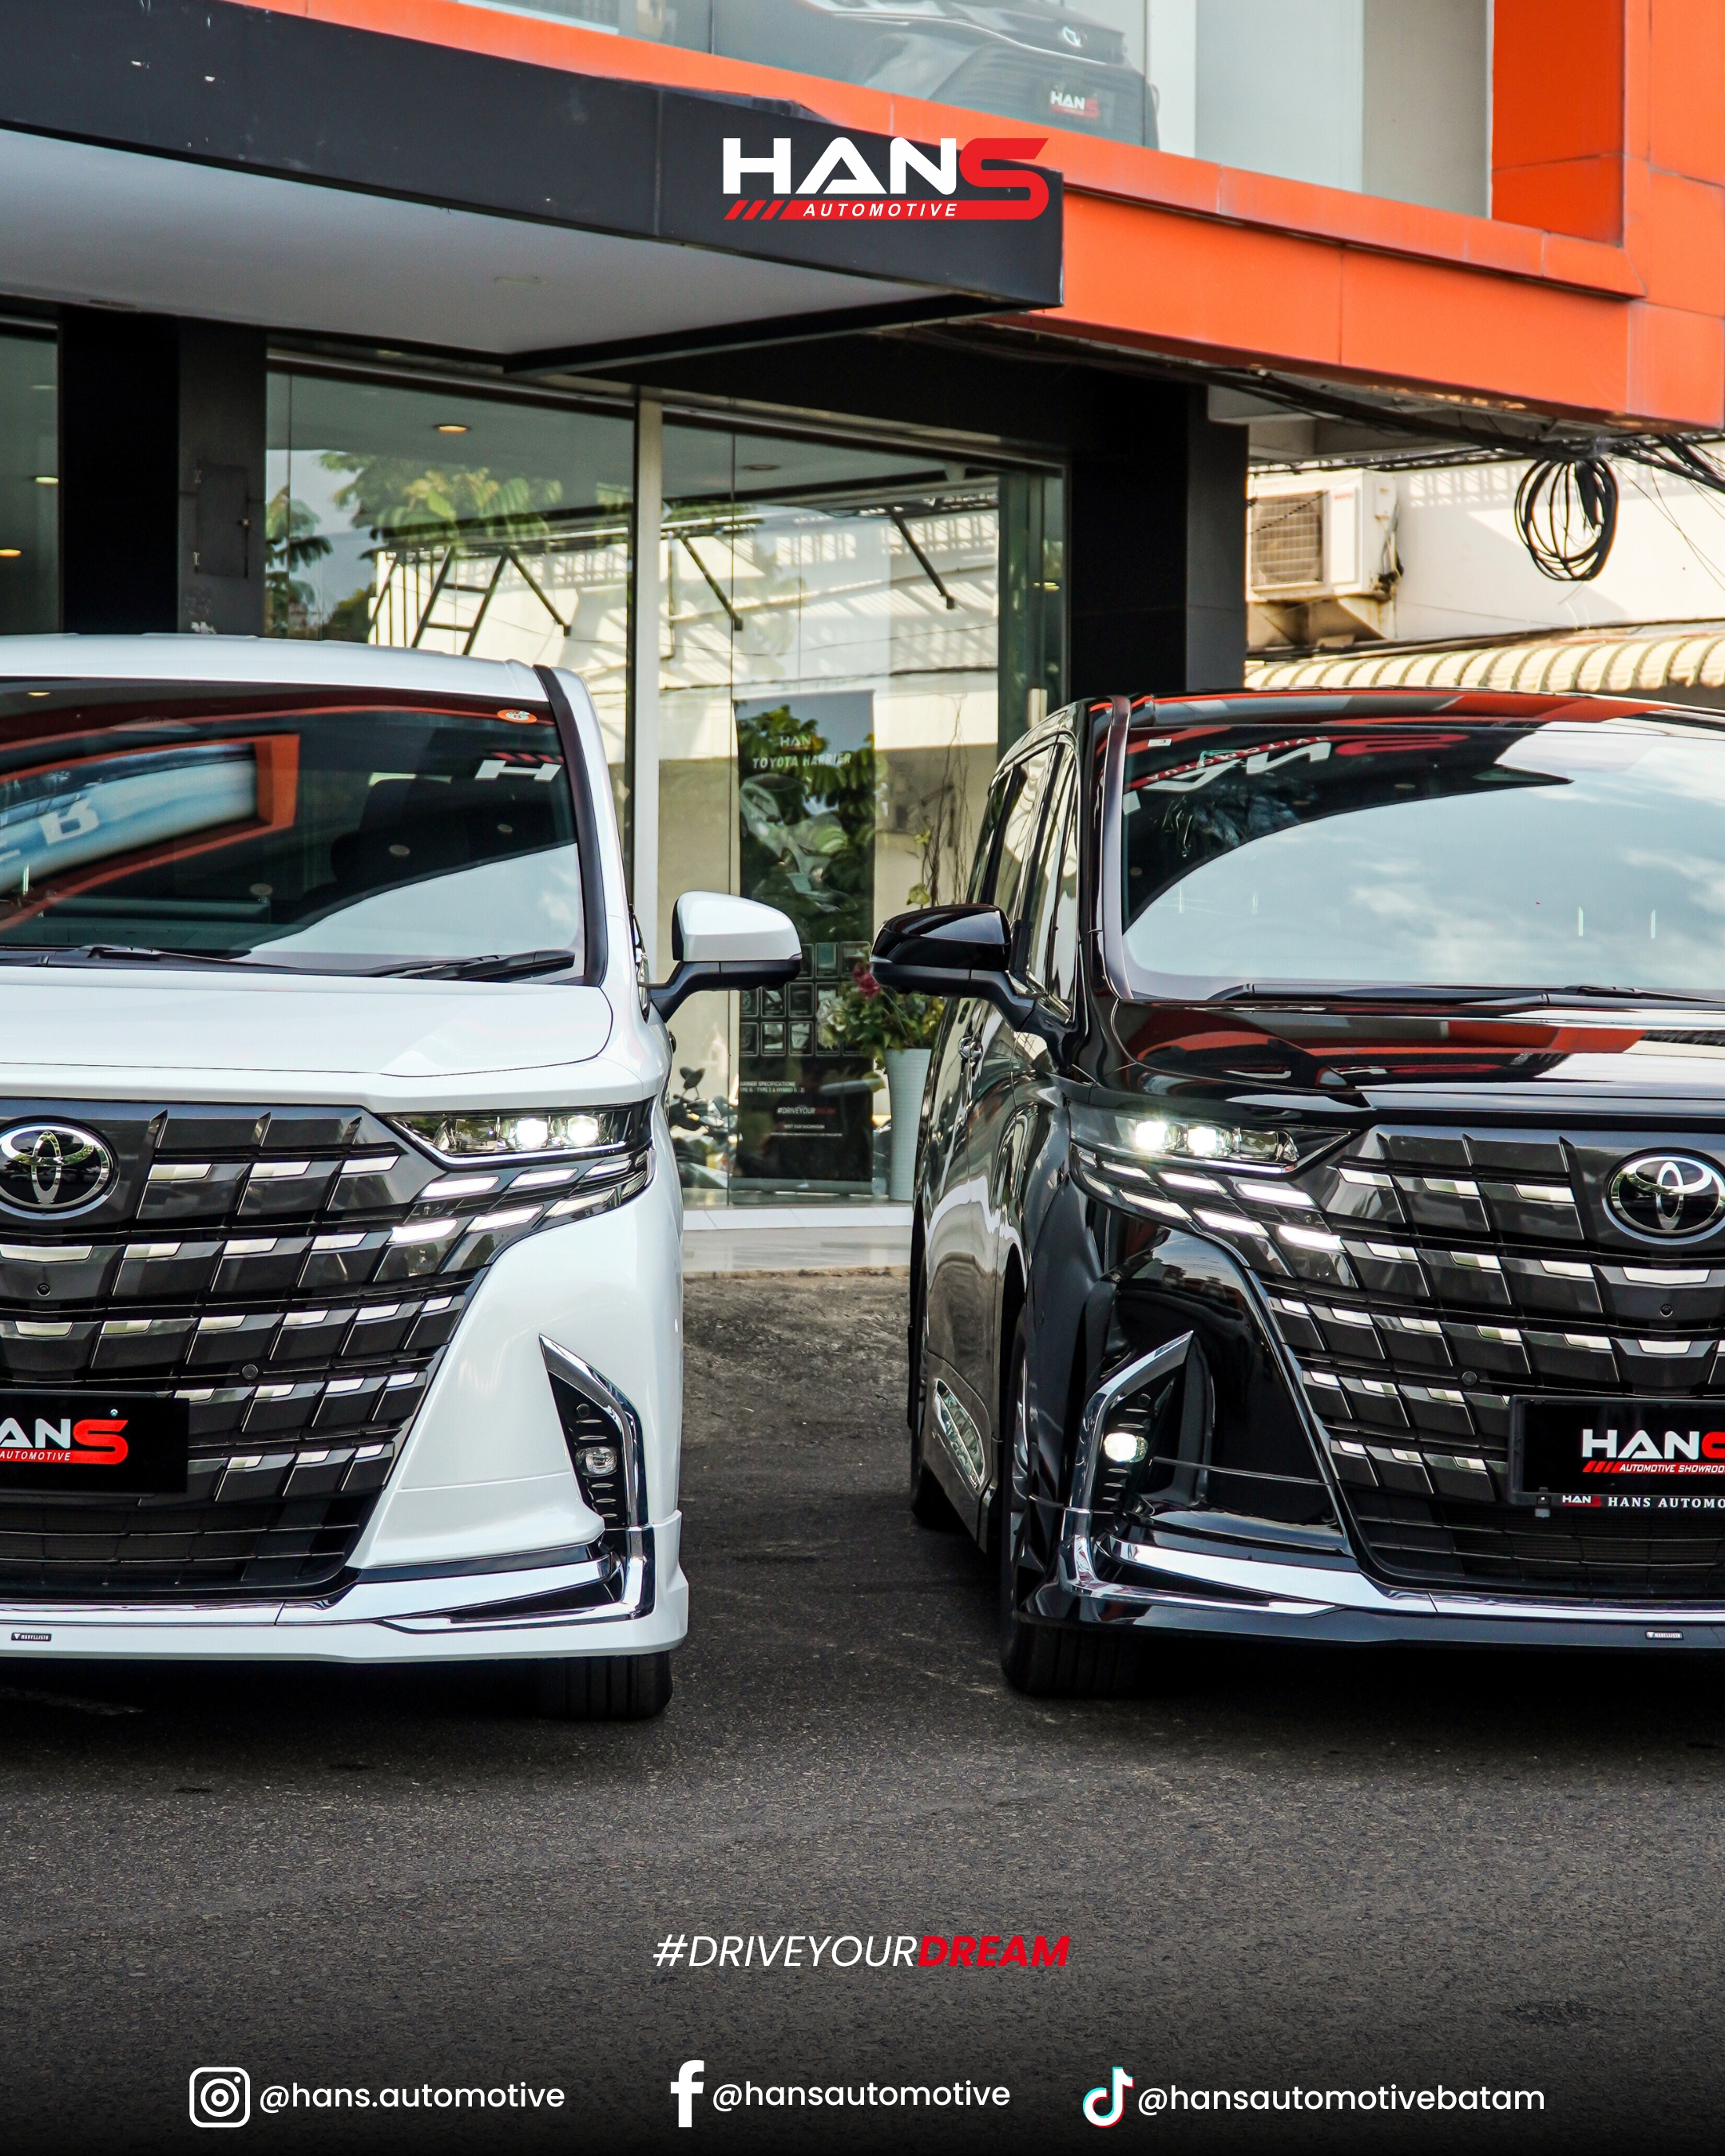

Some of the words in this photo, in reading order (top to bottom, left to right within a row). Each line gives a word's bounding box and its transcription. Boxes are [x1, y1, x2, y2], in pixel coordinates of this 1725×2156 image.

[752, 755, 799, 769] TOYOTA
[0, 1450, 71, 1462] AUTOMOTIVE
[1620, 1464, 1676, 1472] AUTOMOTIVE
[1678, 1464, 1725, 1473] SHOWROO
[1608, 1496, 1652, 1508] HANS
